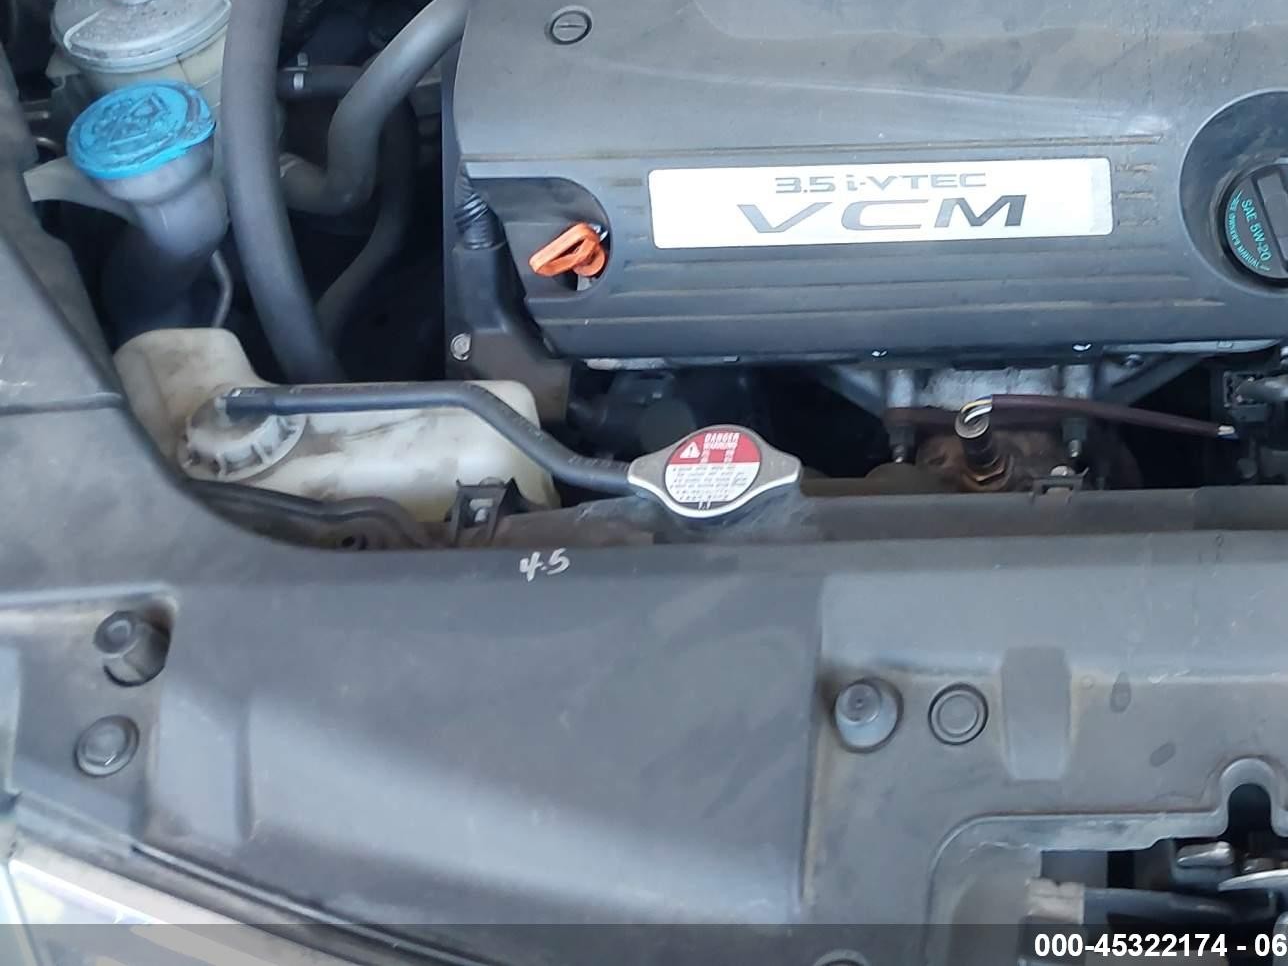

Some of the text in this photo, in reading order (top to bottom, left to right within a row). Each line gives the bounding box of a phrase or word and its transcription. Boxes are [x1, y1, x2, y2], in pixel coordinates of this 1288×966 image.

[775, 172, 986, 194] 3.5 i-VTEC
[737, 194, 1027, 234] VCM
[1241, 199, 1273, 262] SAE 5W-20
[1236, 244, 1261, 269] MANUAL
[704, 432, 740, 443] DANGER
